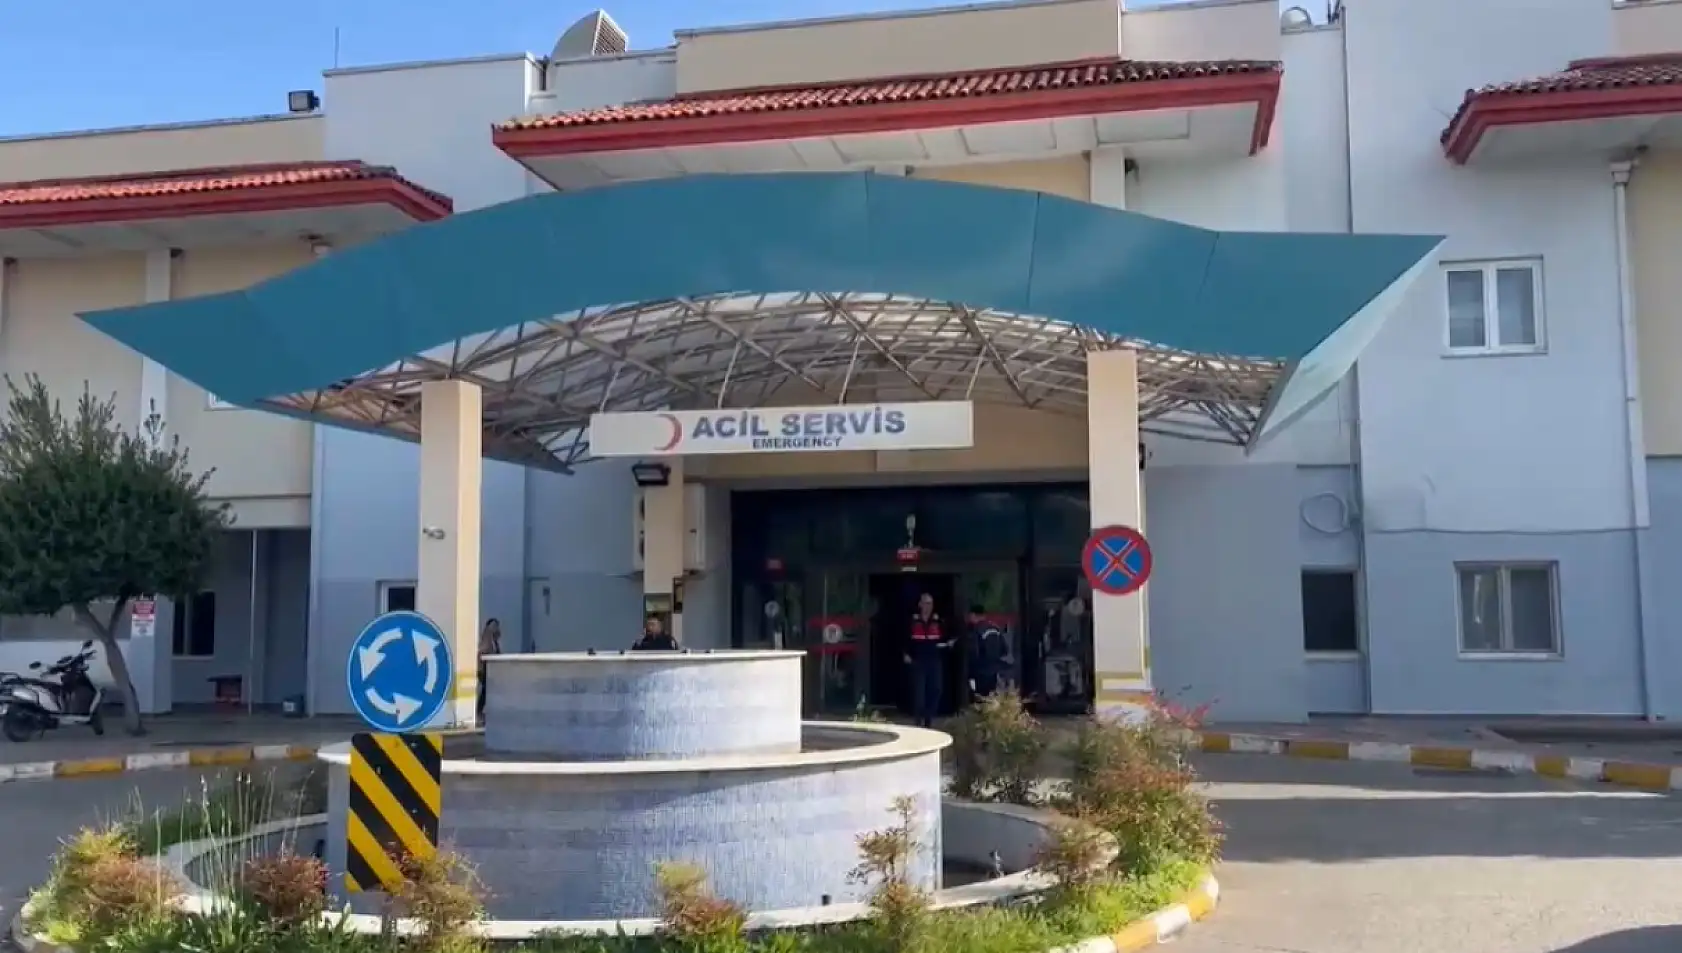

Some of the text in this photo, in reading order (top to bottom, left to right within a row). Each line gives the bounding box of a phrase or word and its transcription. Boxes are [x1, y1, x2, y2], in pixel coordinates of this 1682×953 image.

[692, 406, 906, 439] ACİL SERVİS
[752, 436, 843, 449] EMERGENCY
